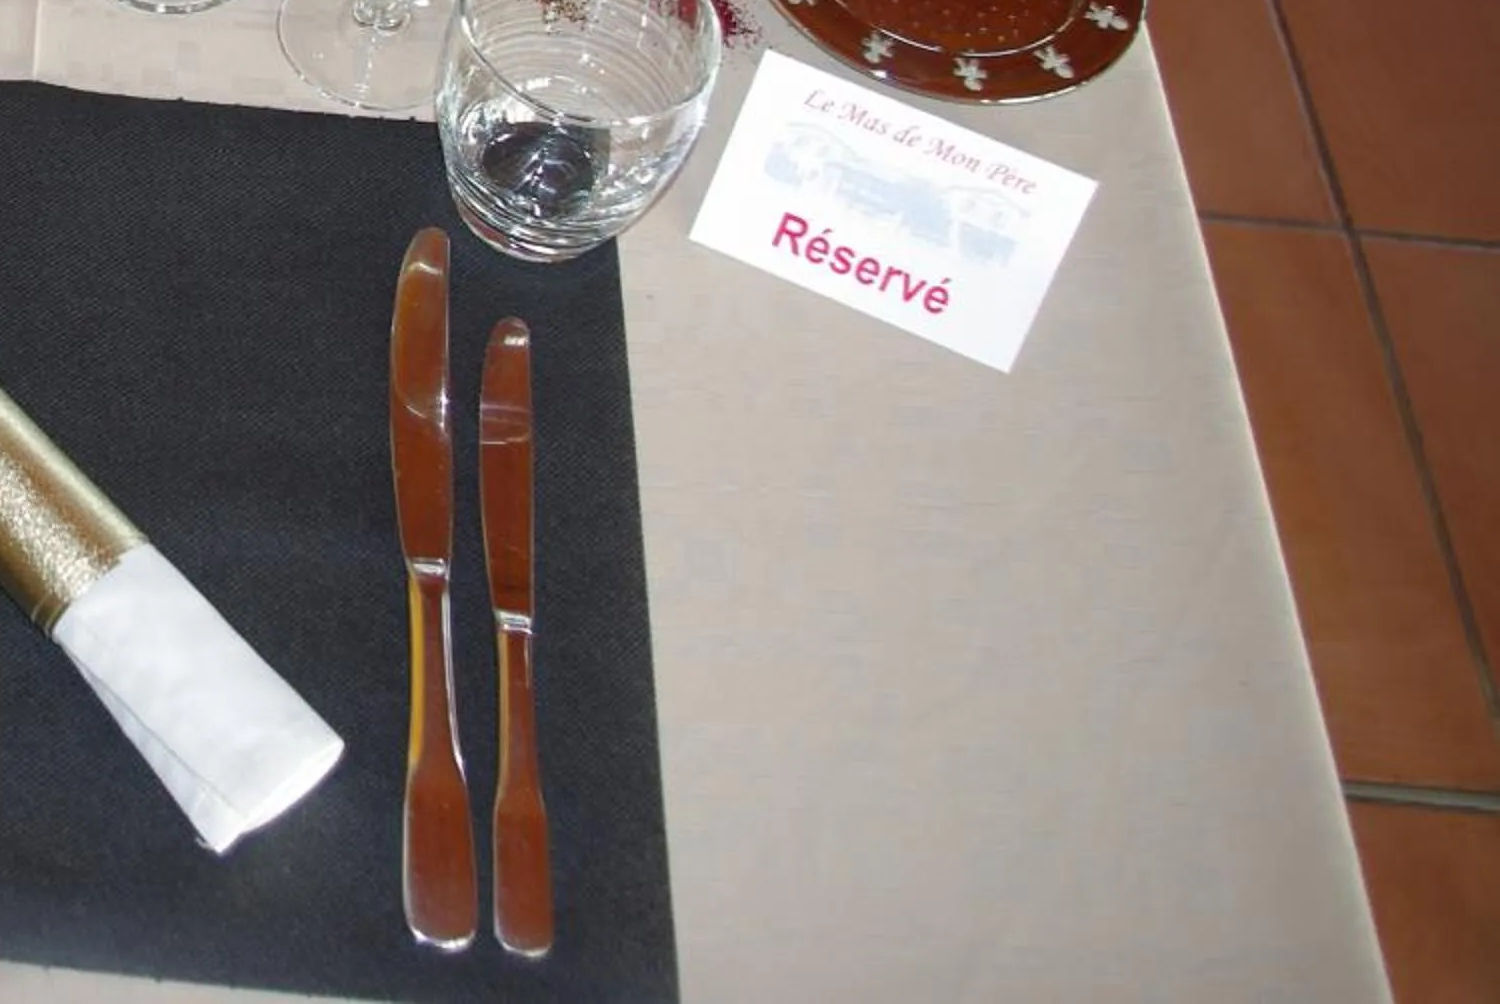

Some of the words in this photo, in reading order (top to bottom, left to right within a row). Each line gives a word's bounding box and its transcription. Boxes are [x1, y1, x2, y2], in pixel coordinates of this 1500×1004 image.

[804, 89, 834, 112] Le
[837, 103, 888, 136] Mas
[893, 124, 924, 149] de
[925, 137, 982, 173] Mon
[985, 164, 1037, 195] Père
[771, 212, 952, 314] Réservé
